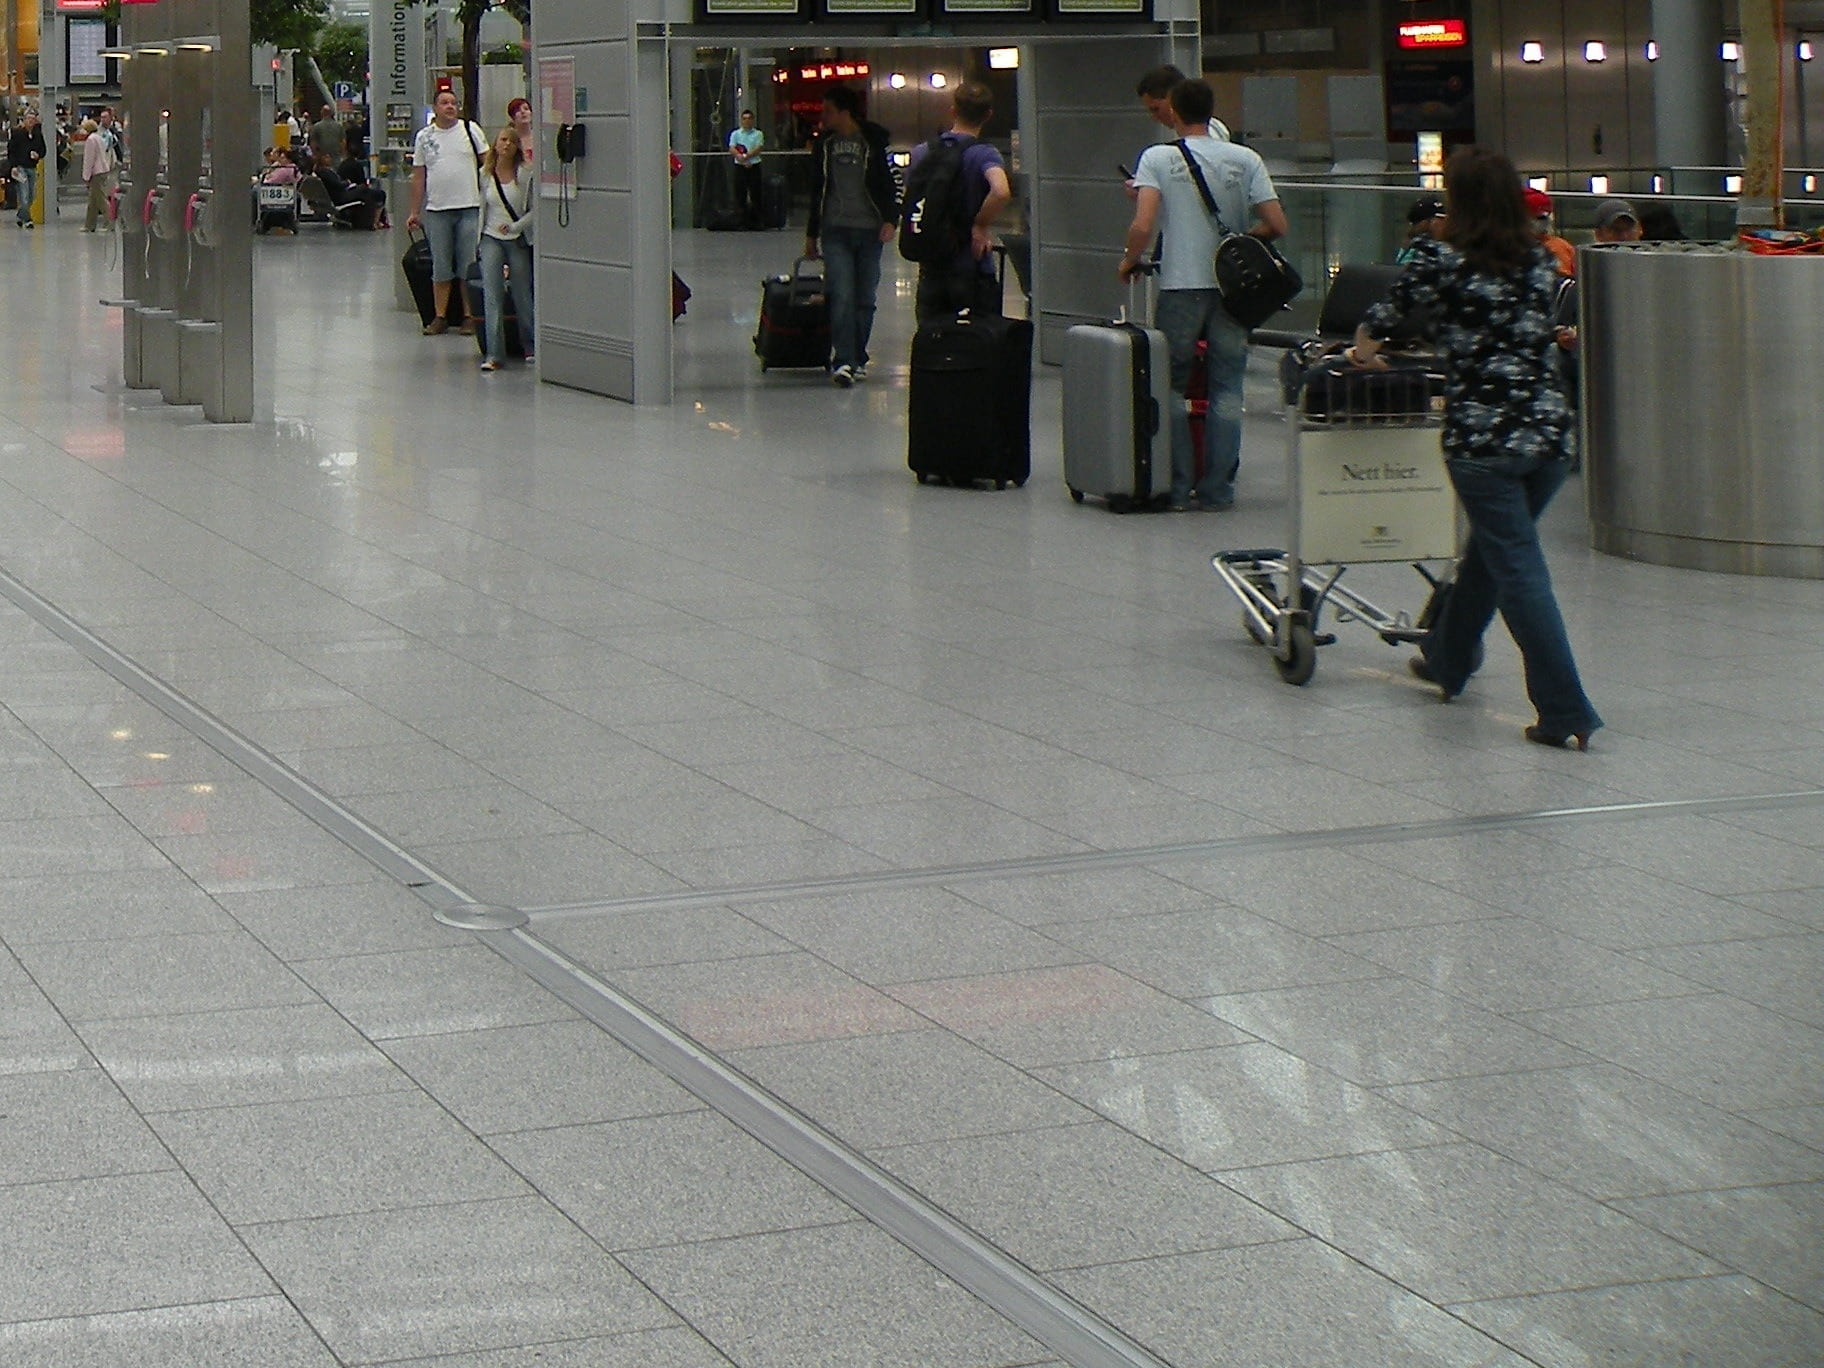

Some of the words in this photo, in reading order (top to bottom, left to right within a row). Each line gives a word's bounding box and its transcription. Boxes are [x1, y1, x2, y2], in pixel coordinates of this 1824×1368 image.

[390, 1, 407, 97] Information
[910, 197, 926, 234] FILA
[1341, 463, 1381, 481] Nett
